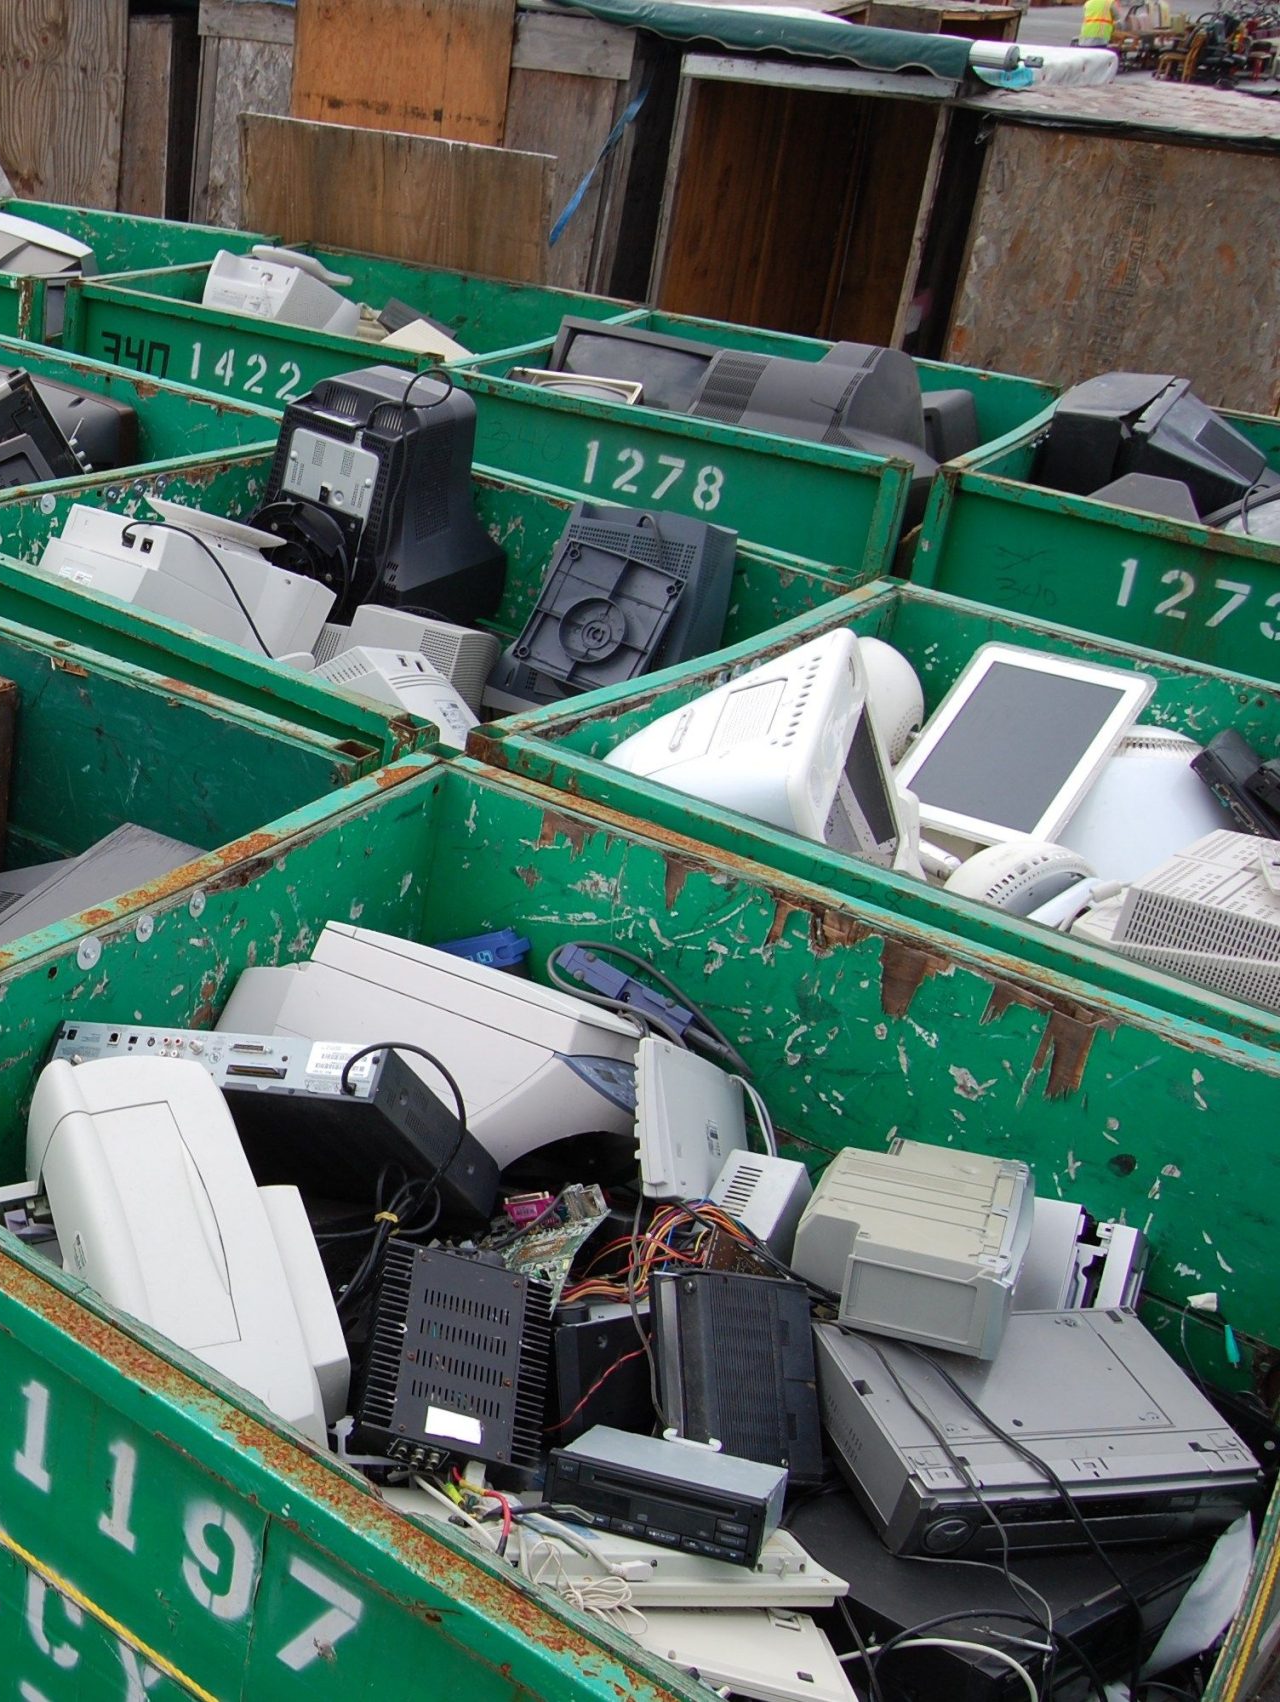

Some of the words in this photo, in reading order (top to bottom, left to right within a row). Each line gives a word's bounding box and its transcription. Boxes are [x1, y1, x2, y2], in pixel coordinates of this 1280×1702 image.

[190, 342, 301, 402] 1422
[583, 439, 725, 511] 1278
[14, 1378, 363, 1672] 1197
